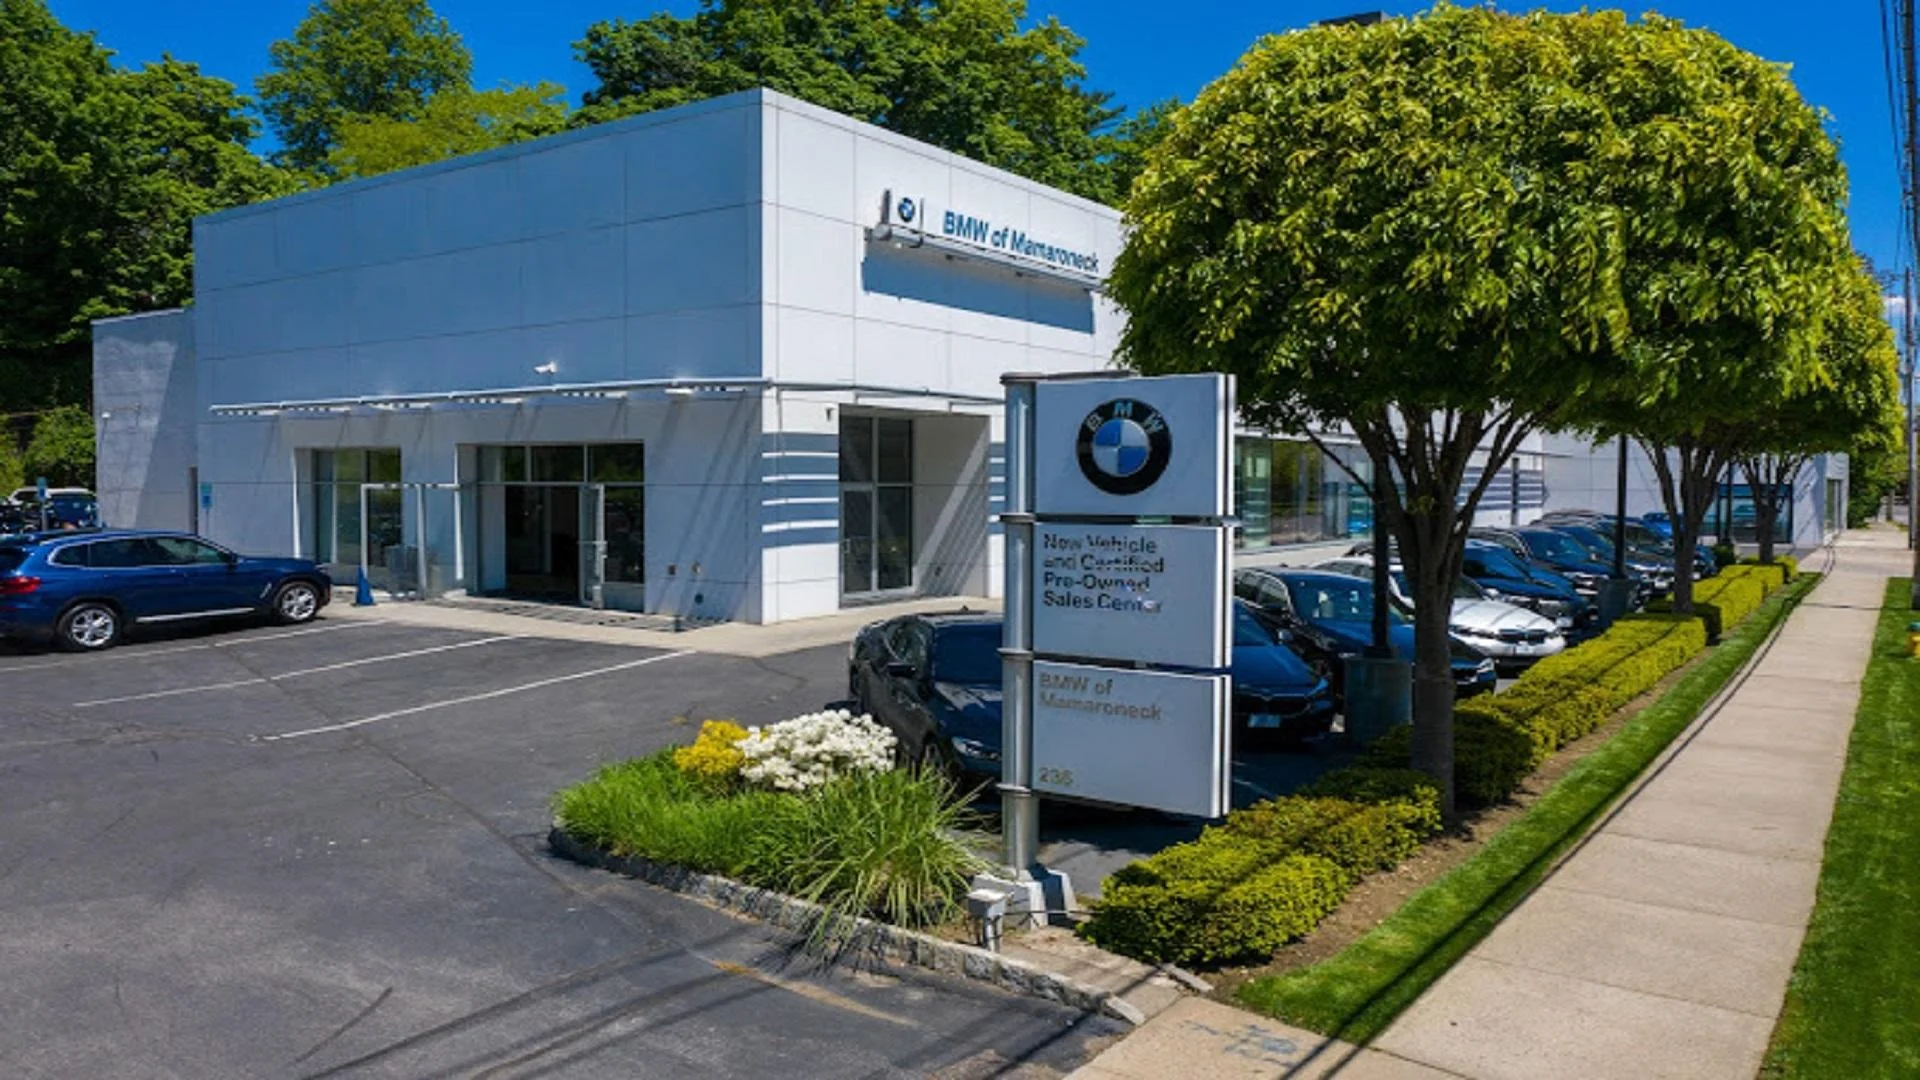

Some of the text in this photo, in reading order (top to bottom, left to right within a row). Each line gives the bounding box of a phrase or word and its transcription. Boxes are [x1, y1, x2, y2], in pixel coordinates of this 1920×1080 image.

[943, 210, 1099, 272] BMW of Mamaroneck
[1086, 534, 1158, 554] Vehicle
[1043, 554, 1165, 574] and Certified
[1043, 571, 1151, 592] Pre-Owned
[1043, 590, 1094, 609] Sales
[1040, 672, 1113, 695] BMW of
[1040, 691, 1162, 720] Mamaroneck
